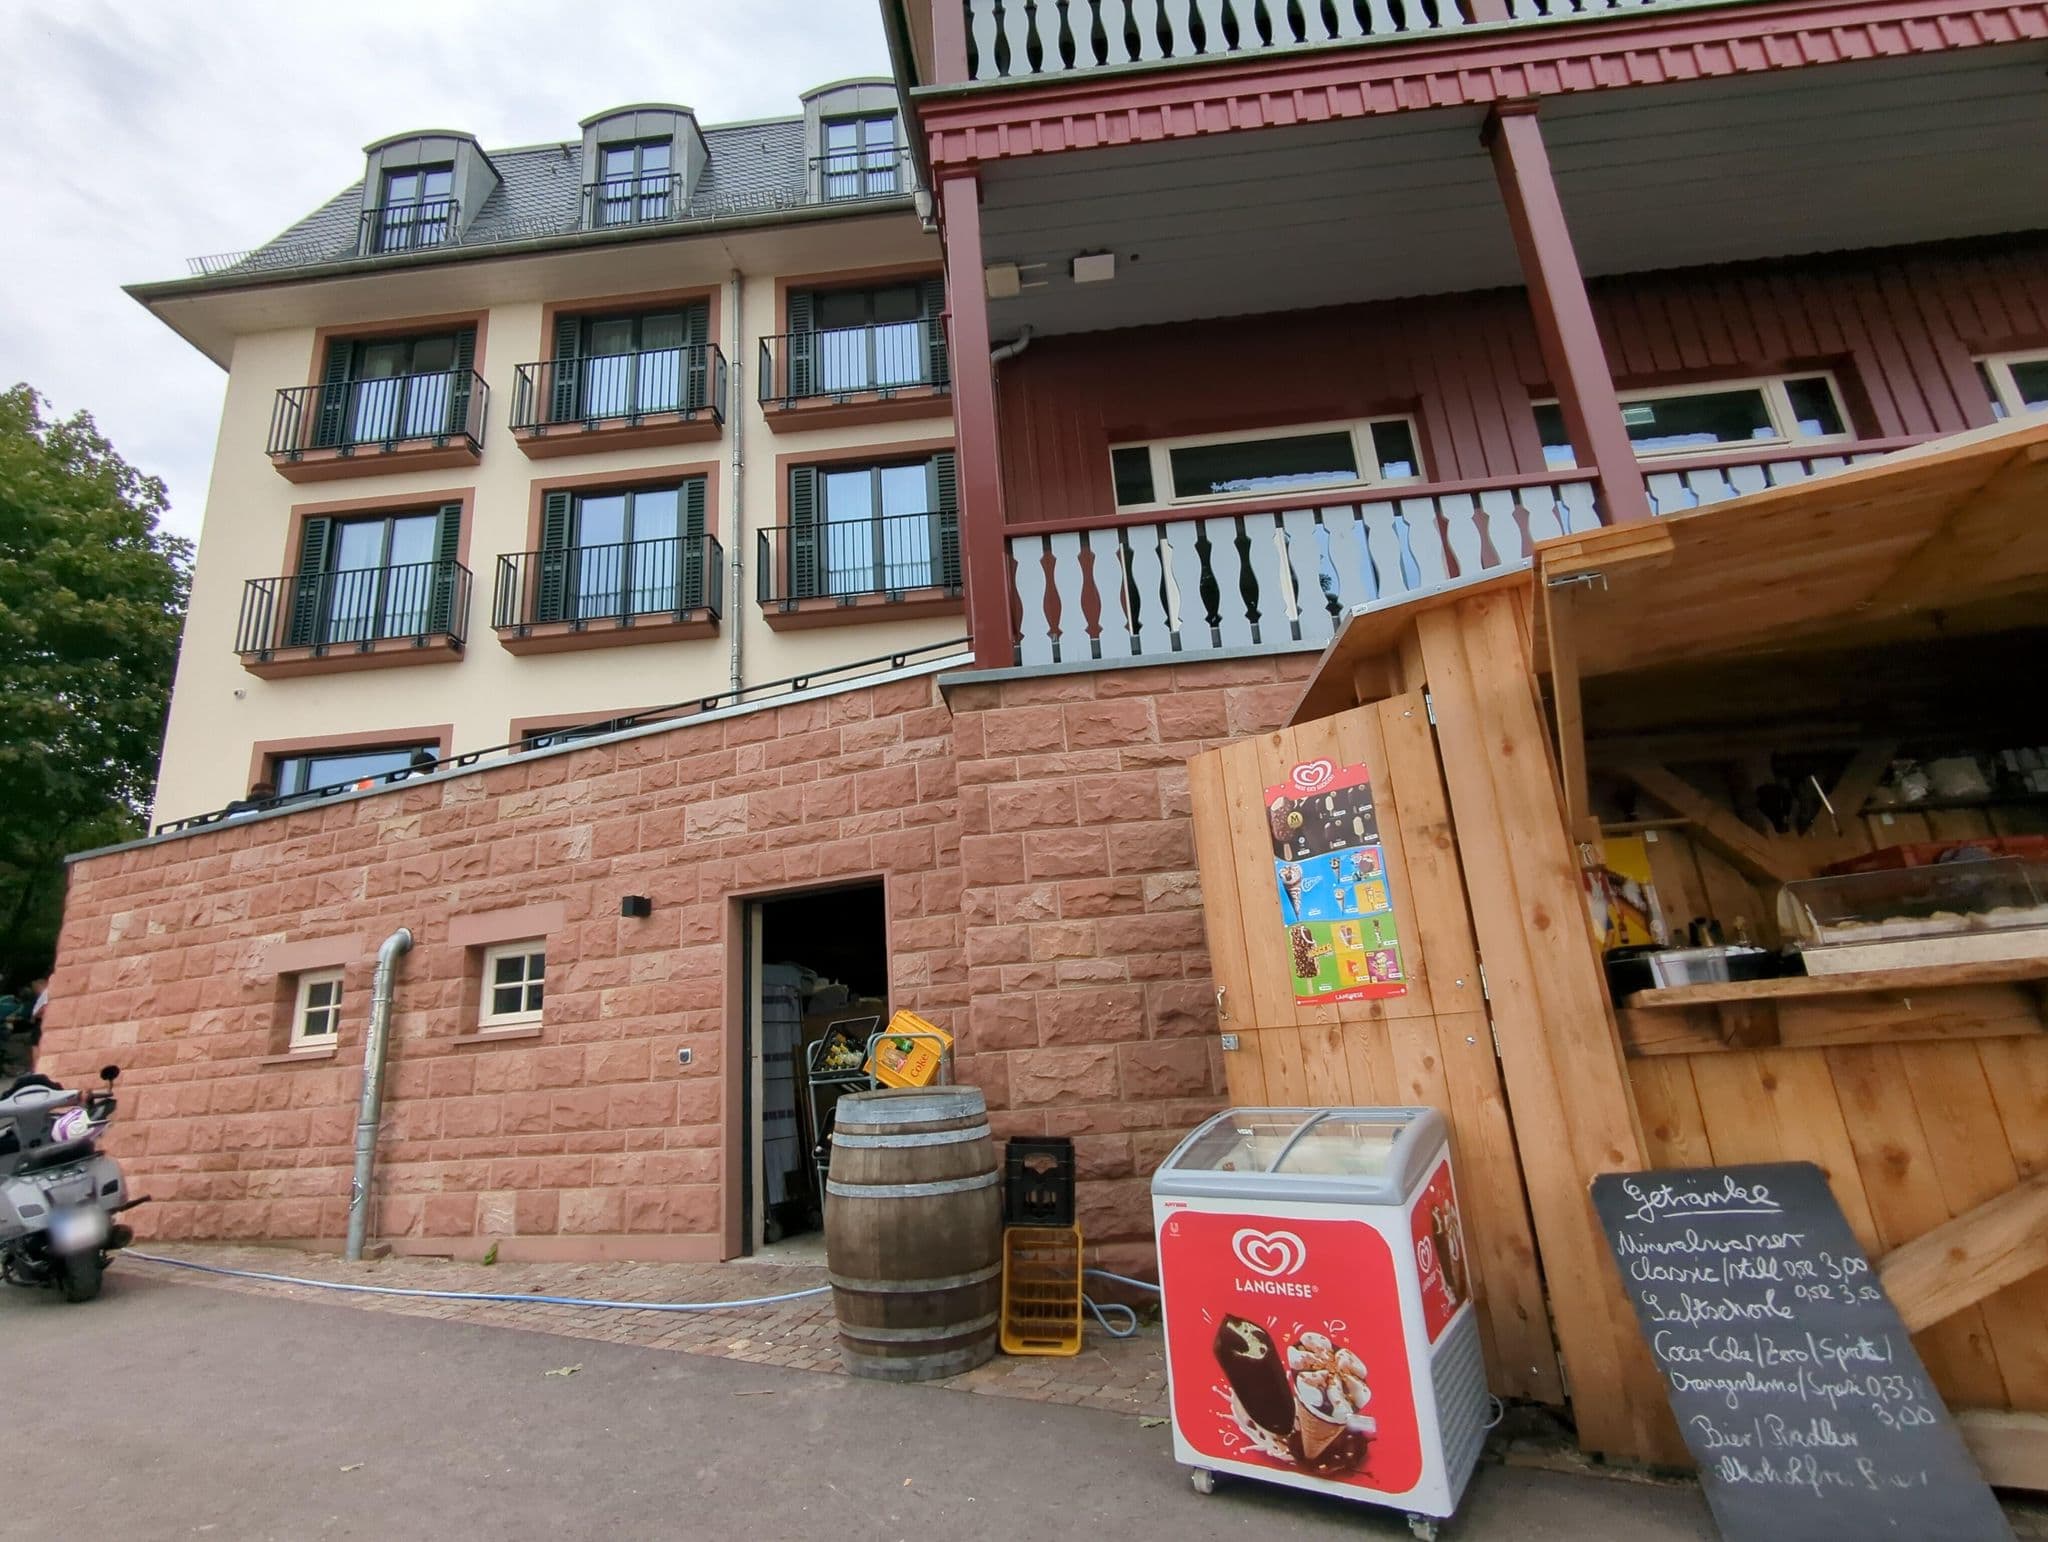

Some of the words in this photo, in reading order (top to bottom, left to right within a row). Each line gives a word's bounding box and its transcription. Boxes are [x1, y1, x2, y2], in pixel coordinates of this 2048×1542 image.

[910, 1053, 929, 1078] Coke
[1622, 1174, 1780, 1223] Getränke
[1617, 1228, 1804, 1256] Mineralwasser
[1819, 1251, 1869, 1284] 3,00
[1838, 1283, 1881, 1307] 3,50
[1871, 1402, 1937, 1431] 3,00
